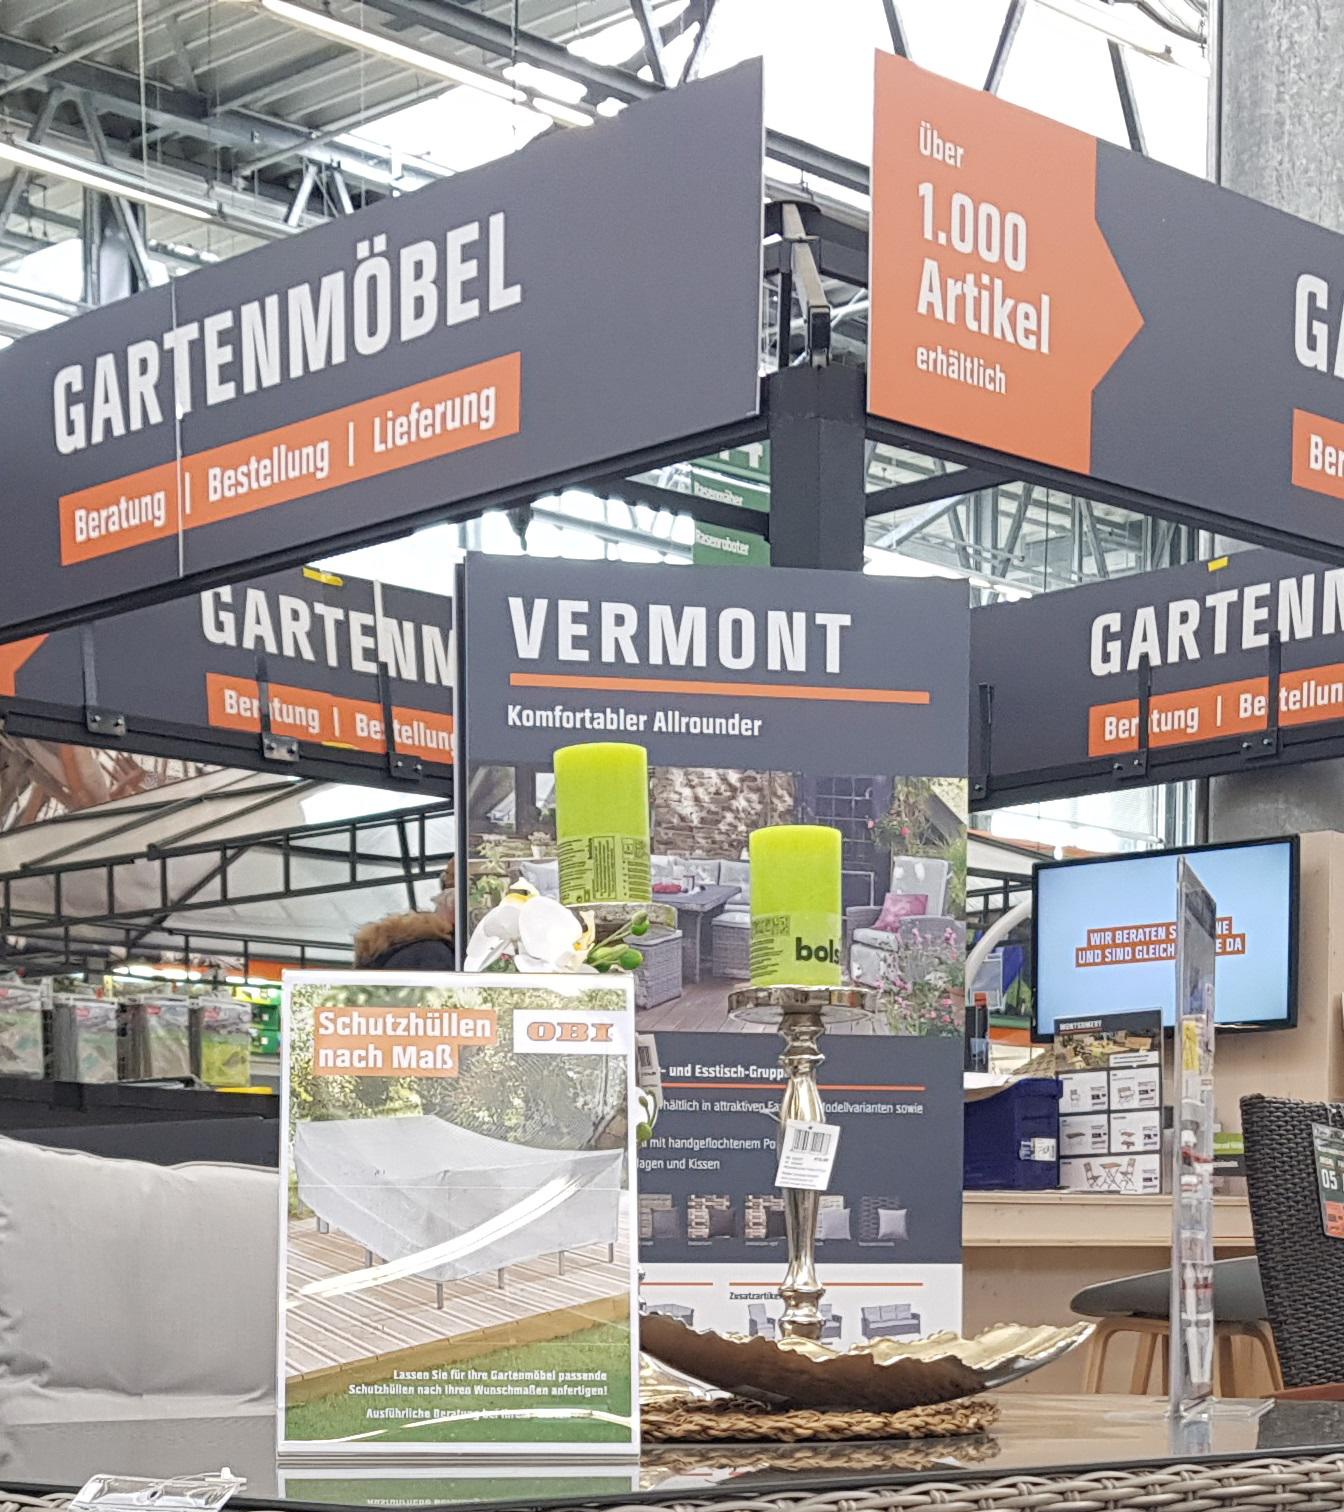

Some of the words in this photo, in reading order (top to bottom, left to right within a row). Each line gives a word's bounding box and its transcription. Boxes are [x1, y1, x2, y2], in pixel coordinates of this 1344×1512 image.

[919, 120, 964, 168] Über
[918, 182, 1027, 273] 1.000
[917, 257, 1050, 354] Artikel
[53, 211, 522, 455] GARTENMÖBEL
[916, 345, 1007, 395] erhältlich
[74, 489, 166, 543] Beratung
[208, 440, 329, 501] Bestellung
[373, 386, 496, 453] Lieferung
[508, 597, 851, 673] VERMONT
[224, 688, 320, 734] Bertung
[356, 712, 454, 757] Betellun
[507, 705, 647, 731] Komfortabler
[653, 710, 762, 736] Allrounder
[1104, 706, 1199, 742] Bertung
[1090, 927, 1112, 945] WIR
[1115, 924, 1166, 943] BERATEN
[1078, 950, 1102, 964] UND
[1105, 948, 1131, 962] SIND
[1135, 943, 1175, 960] GLEICH
[1226, 937, 1243, 952] DA
[318, 1011, 491, 1038] Schutzhüllen
[526, 1021, 614, 1042] OBI
[318, 1044, 383, 1069] nach
[392, 1044, 454, 1069] Maß
[669, 1063, 692, 1077] und
[695, 1064, 788, 1080] Esstisch-Grupp
[702, 1100, 711, 1110] in
[714, 1101, 766, 1111] attraktiven
[822, 1102, 894, 1113] odellvarianten
[895, 1103, 924, 1114] sowie
[650, 1138, 666, 1149] mit
[668, 1137, 761, 1150] handgeflochtenem
[636, 1158, 663, 1171] lagen
[667, 1158, 686, 1169] und
[689, 1159, 721, 1169] Kissen
[393, 1369, 429, 1380] Lassen
[432, 1369, 448, 1380] Sie
[451, 1369, 466, 1380] für
[468, 1369, 488, 1380] Ihre
[491, 1370, 556, 1380] Gartenmöbel
[559, 1370, 608, 1382] passende
[349, 1384, 415, 1394] Schutzhüllen
[417, 1384, 442, 1394] nach
[445, 1384, 471, 1394] Ihren
[474, 1385, 549, 1395] Wunschmaßen
[551, 1385, 608, 1397] anfertigen!
[366, 1407, 431, 1418] Ausführliche
